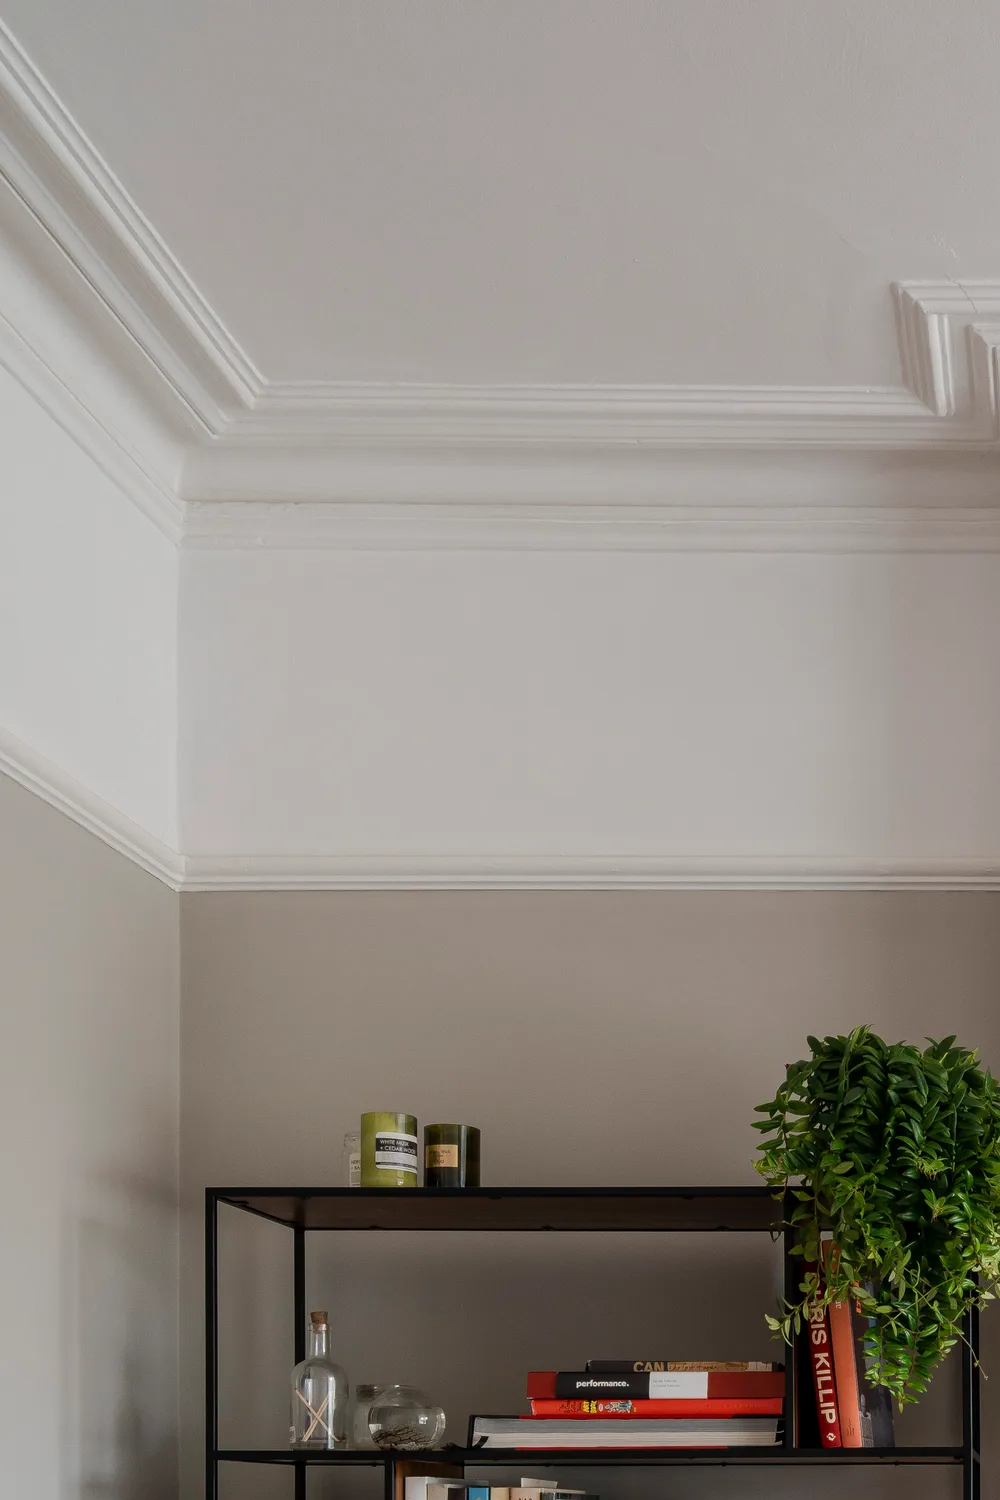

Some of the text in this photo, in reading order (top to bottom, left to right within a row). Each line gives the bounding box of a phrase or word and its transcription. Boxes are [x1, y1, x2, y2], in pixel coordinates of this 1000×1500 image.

[633, 1361, 664, 1372] CAN
[576, 1379, 630, 1389] performance.
[814, 1352, 836, 1424] KILLIP
